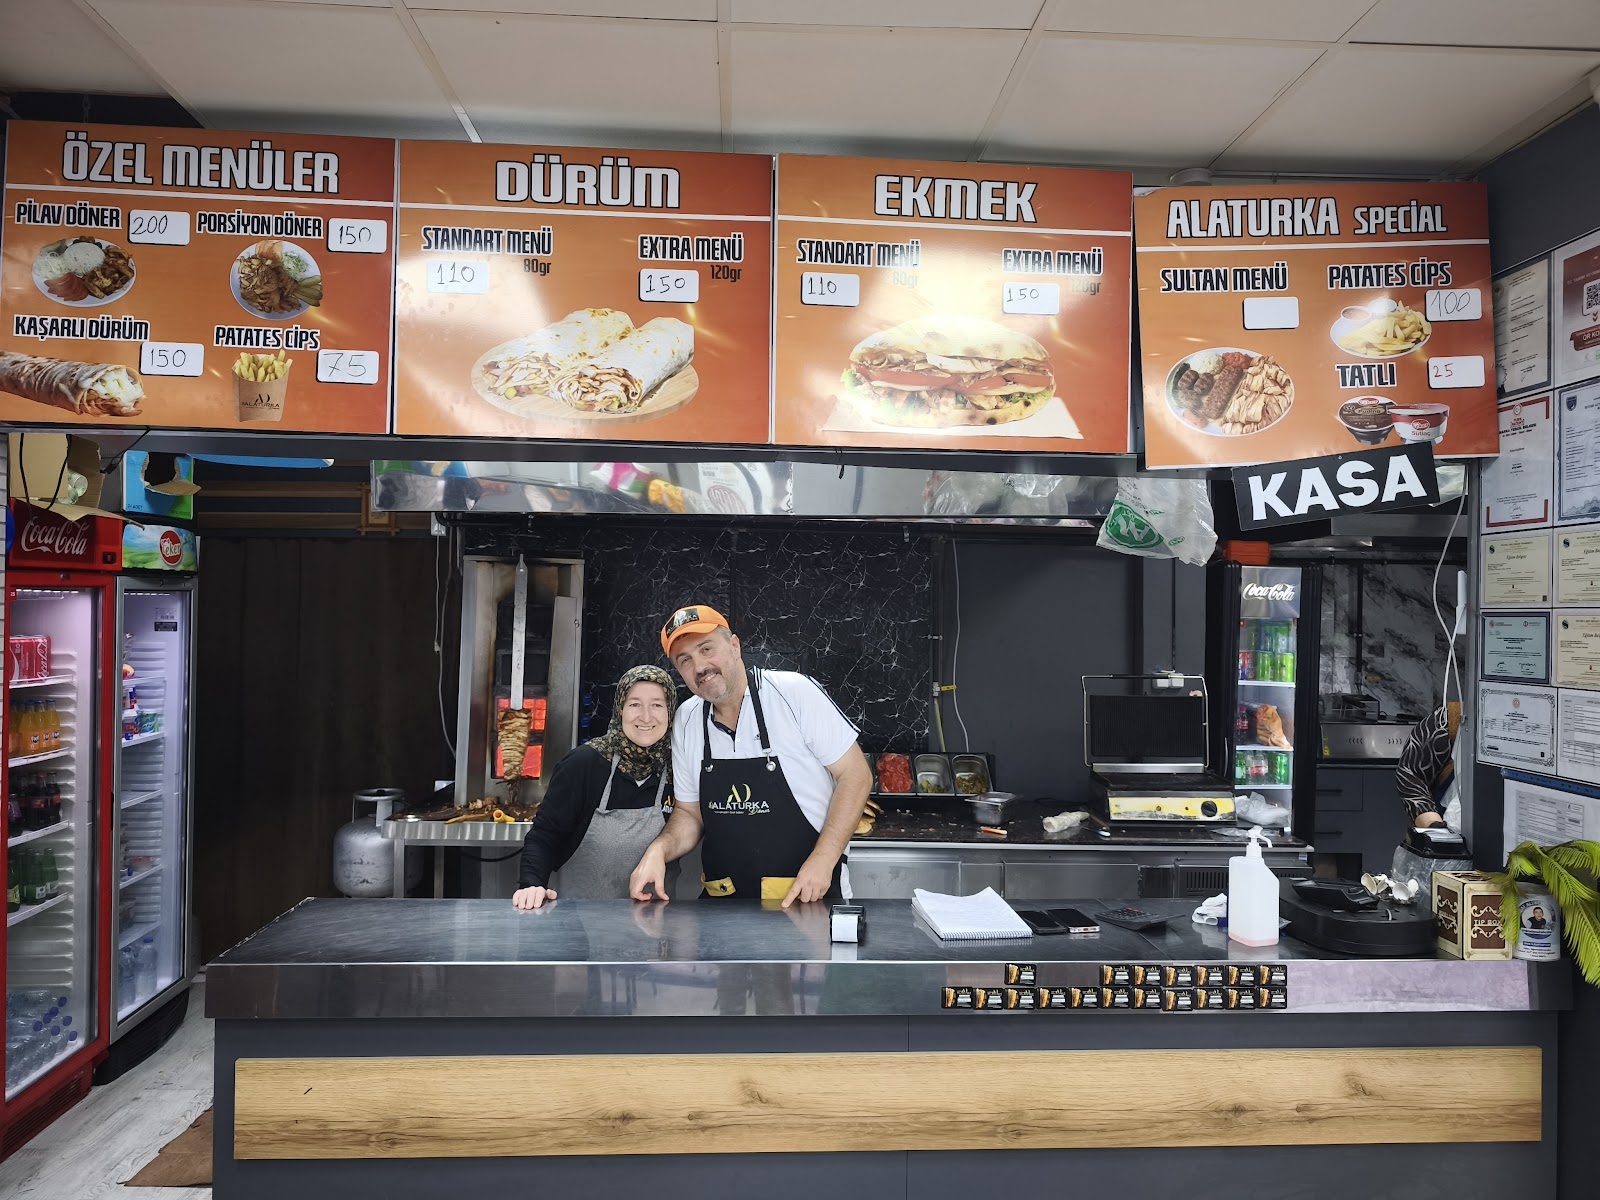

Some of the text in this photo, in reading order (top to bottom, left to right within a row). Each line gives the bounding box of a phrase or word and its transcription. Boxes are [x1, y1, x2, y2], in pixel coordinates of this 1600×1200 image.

[62, 131, 340, 194] ÖZEL MENÜLER
[495, 152, 681, 209] DÜRÜM
[874, 174, 1038, 223] EKMEK
[15, 198, 121, 229] PİLAV DÖNER
[132, 214, 169, 236] 200
[197, 209, 323, 239] PORSİYON DÖNER
[1166, 197, 1448, 239] ALATURKA SPECİAL
[339, 225, 372, 246] 150
[421, 225, 553, 256] STANDART MENÜ
[638, 231, 744, 262] EXTRA MENÜ
[796, 238, 920, 268] STANDART MENÜ
[1003, 246, 1103, 275] EXTRA MENÜ
[436, 261, 475, 285] 110
[523, 257, 552, 276] 80gr
[710, 264, 742, 282] 120gr
[1160, 260, 1289, 293] SULTAN MENÜ
[1328, 257, 1452, 289] PATATES CİPS
[645, 273, 686, 294] 150
[807, 276, 837, 296] 110
[1006, 287, 1039, 302] 150
[1431, 290, 1471, 317] 100
[14, 315, 150, 341] KAŞARLI DÜRÜM
[214, 325, 321, 350] PATATES CİPS
[150, 348, 187, 368] 150
[322, 353, 367, 378] 75
[1432, 362, 1455, 379] 25
[1335, 363, 1397, 388] TATLI
[1249, 454, 1427, 521] KASA
[21, 515, 90, 556] Coca-Cola
[1243, 583, 1296, 601] Coca-Cola
